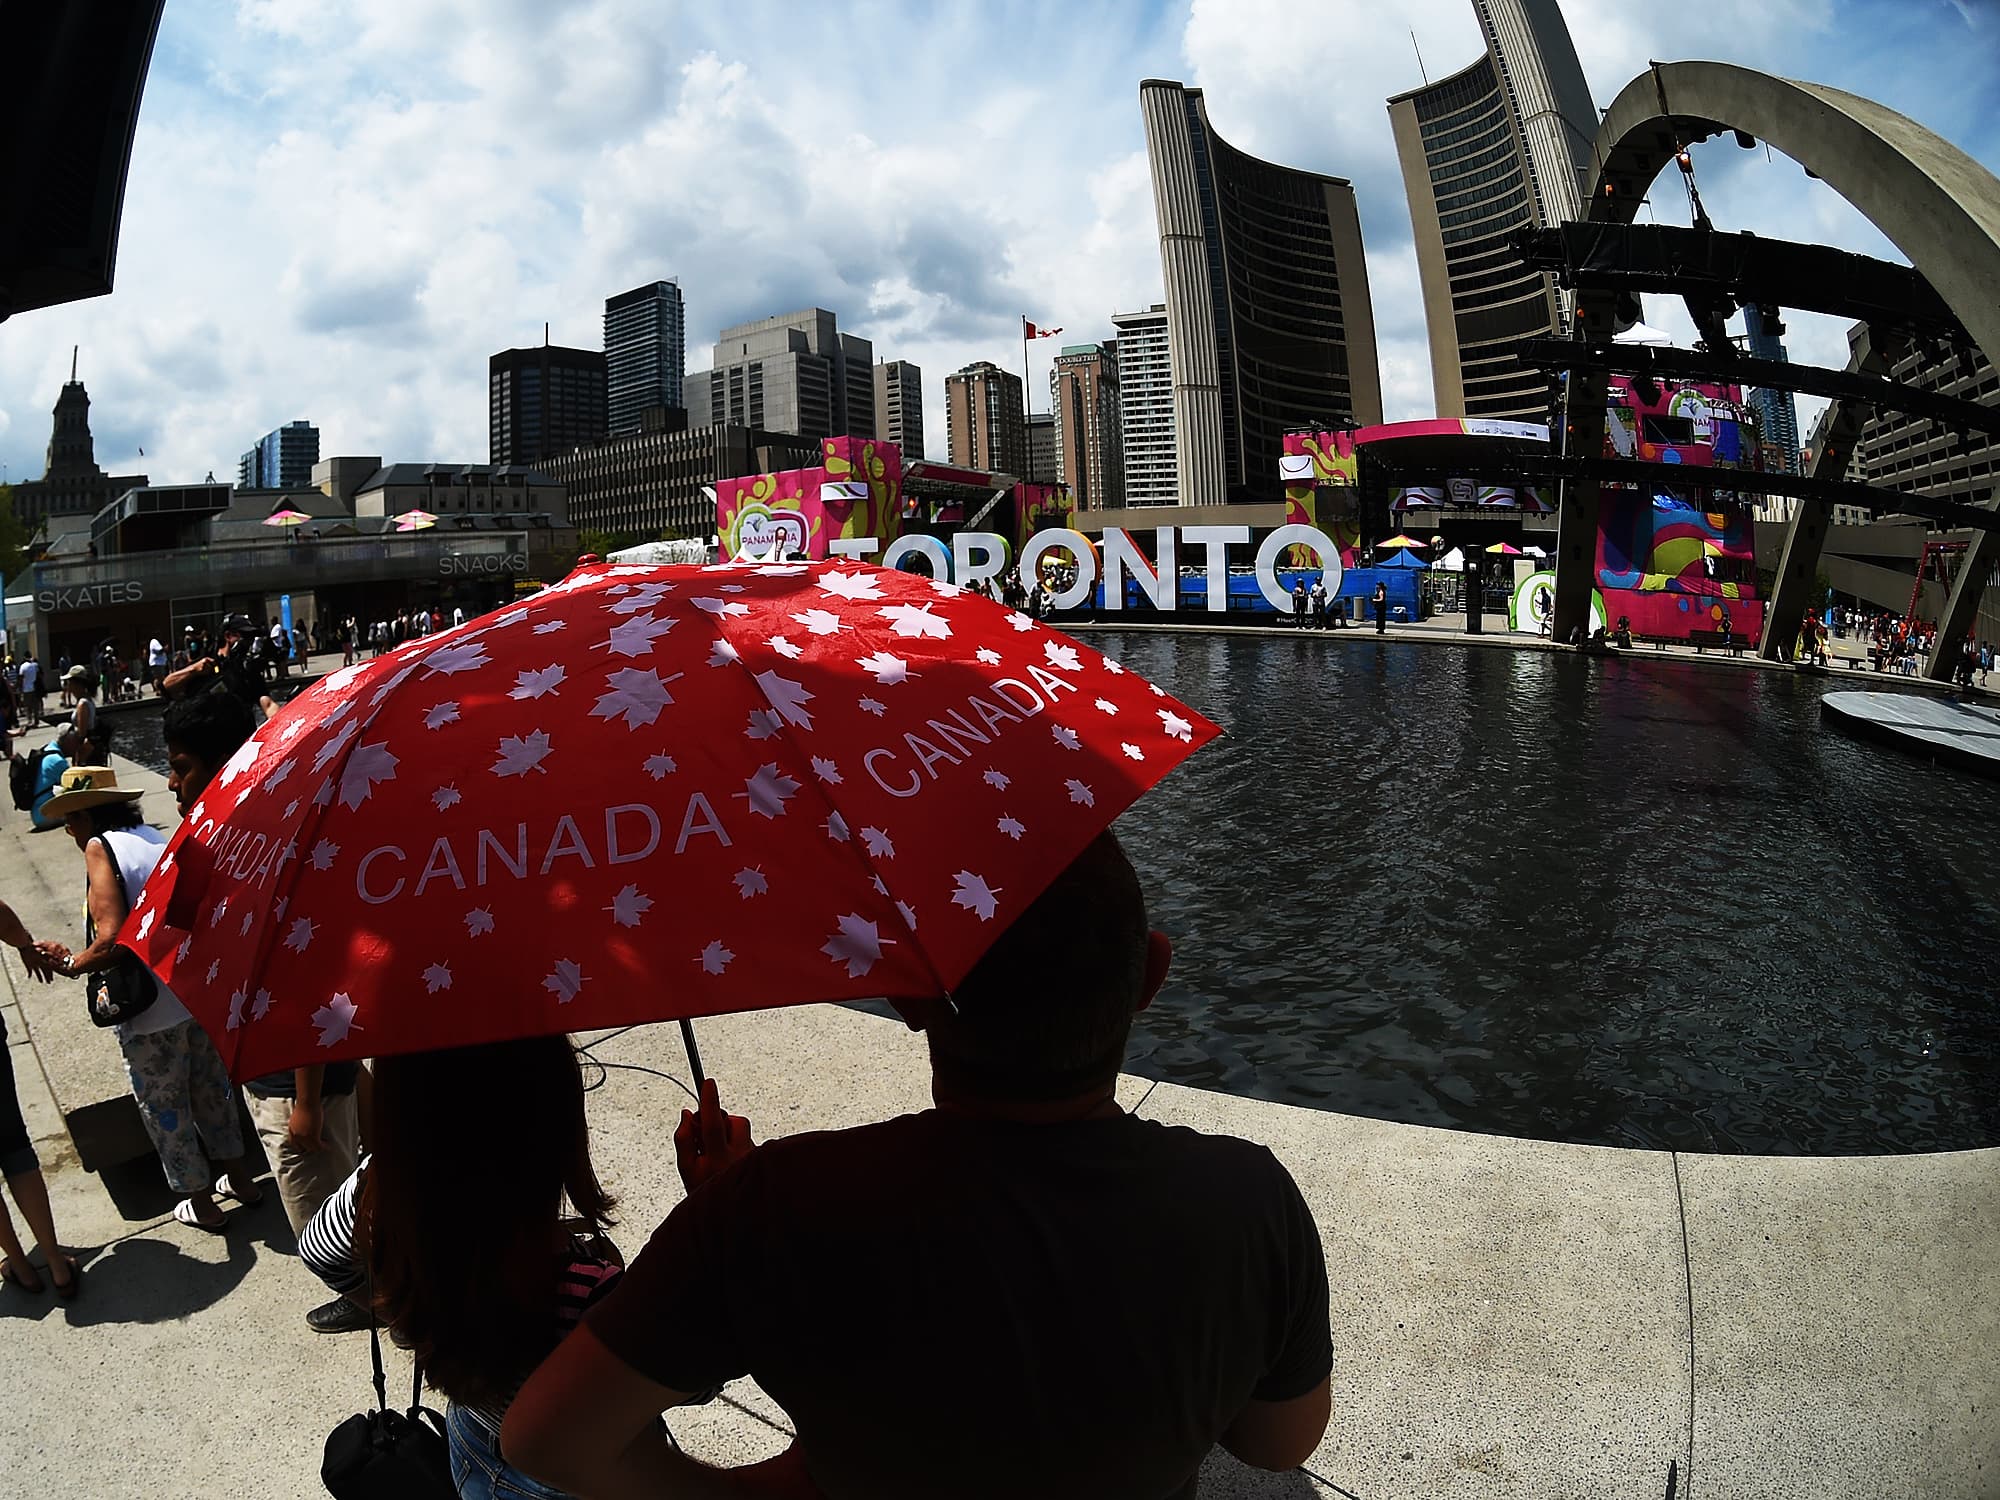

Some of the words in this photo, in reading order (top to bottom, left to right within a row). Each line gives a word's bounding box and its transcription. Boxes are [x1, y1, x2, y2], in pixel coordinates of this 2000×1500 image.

[742, 533, 798, 545] PANAMIA
[439, 554, 526, 575] SNACKS
[38, 581, 143, 612] SKATES
[863, 664, 1078, 797] CANADA
[356, 792, 733, 904] CANADA
